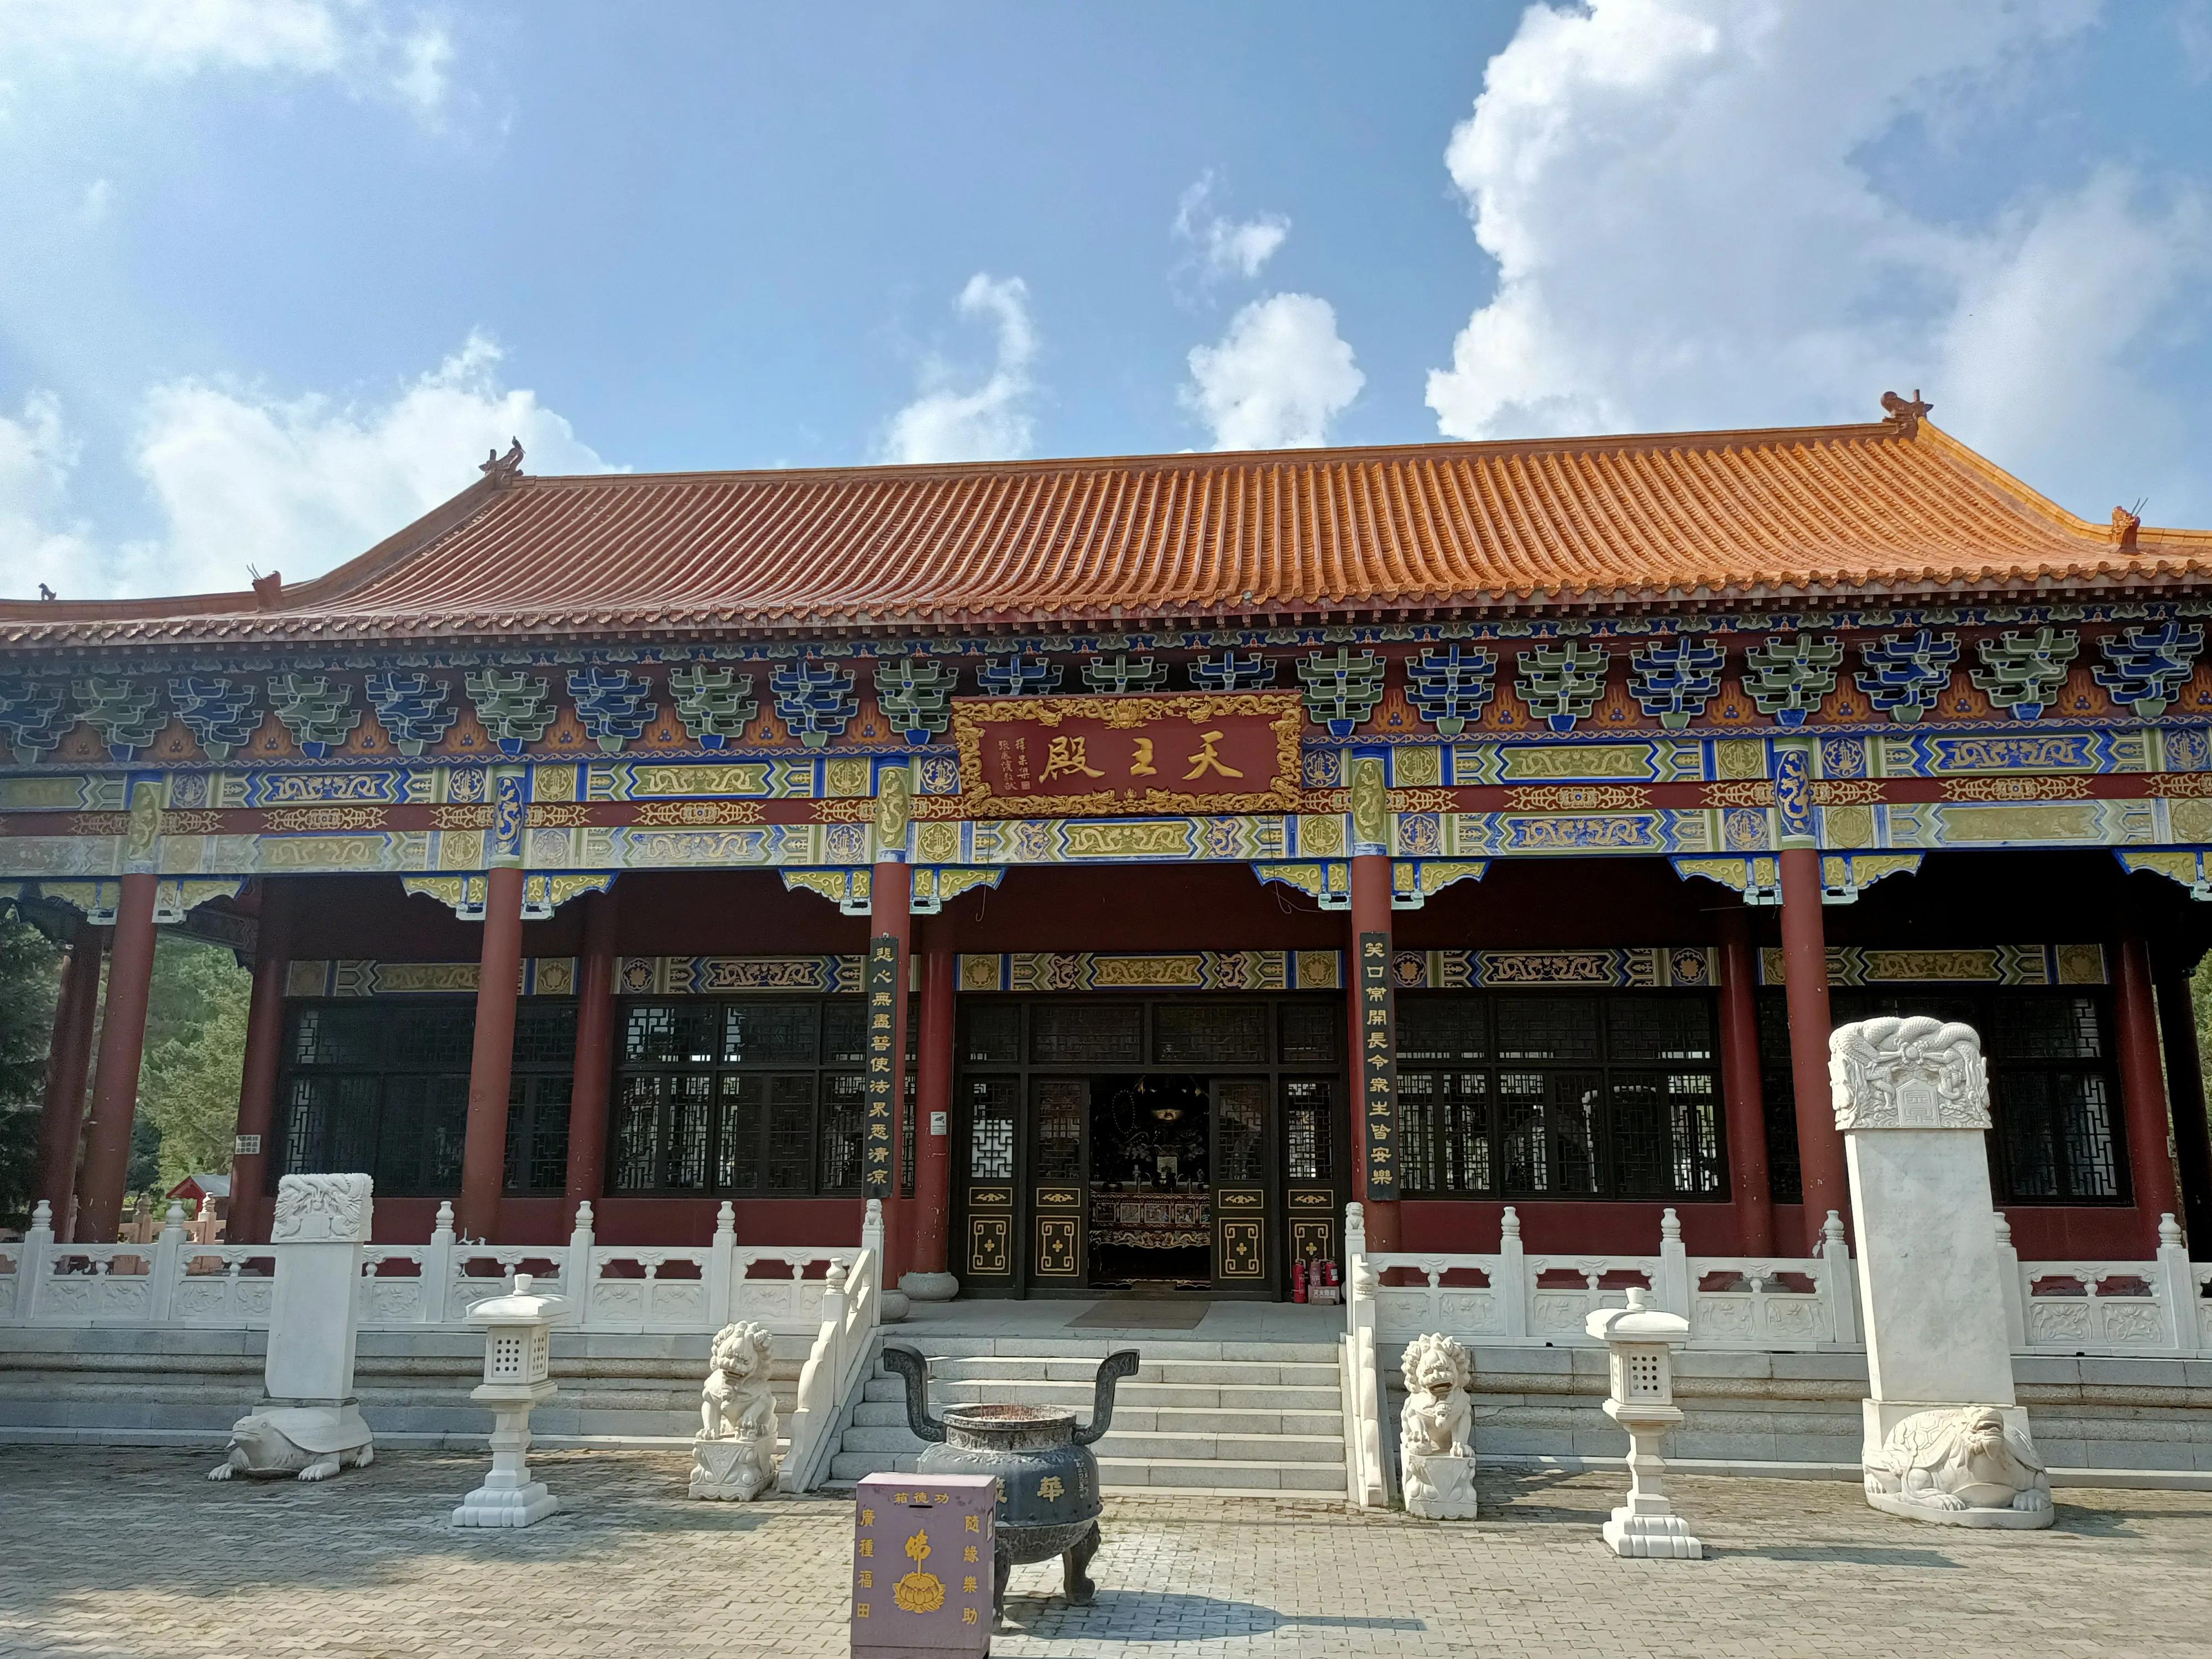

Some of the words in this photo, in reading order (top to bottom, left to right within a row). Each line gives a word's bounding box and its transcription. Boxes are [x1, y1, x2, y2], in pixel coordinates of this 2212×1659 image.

[1039, 730, 1244, 784] 天王殿
[857, 1509, 875, 1619] 廣種福田
[962, 1515, 980, 1625] 隨緣樂助
